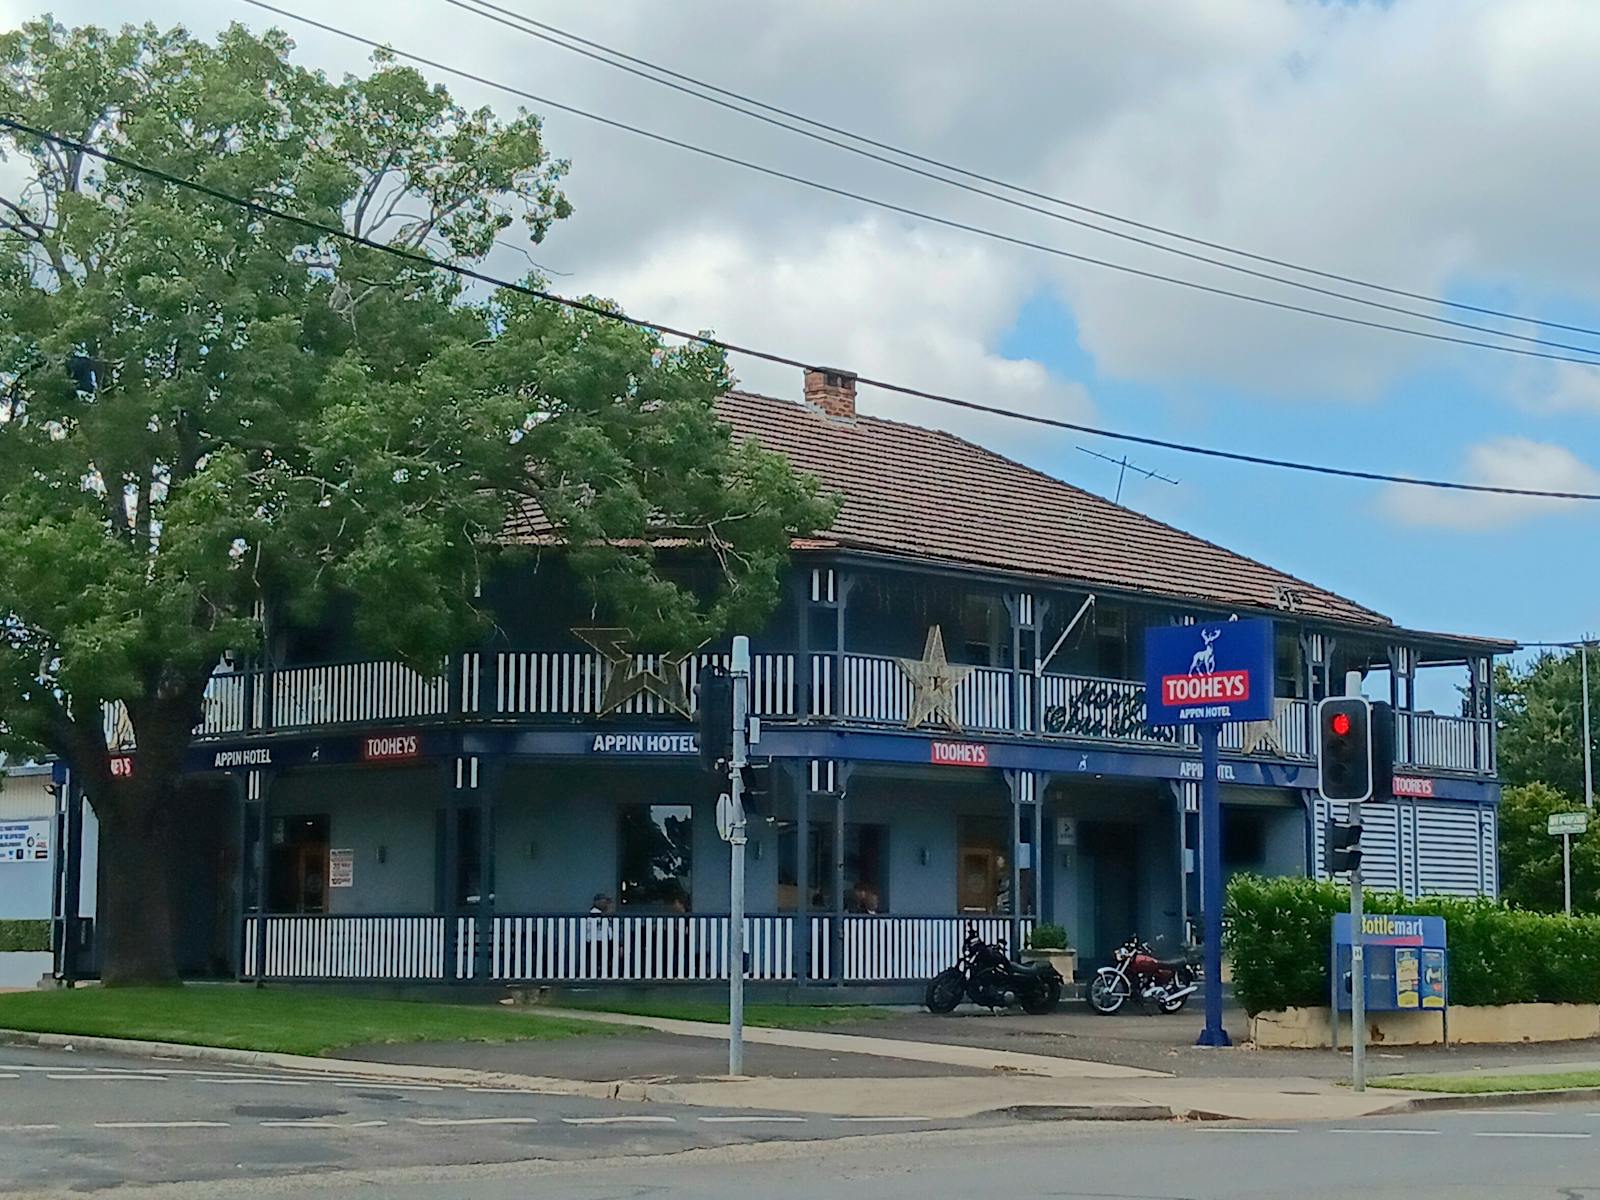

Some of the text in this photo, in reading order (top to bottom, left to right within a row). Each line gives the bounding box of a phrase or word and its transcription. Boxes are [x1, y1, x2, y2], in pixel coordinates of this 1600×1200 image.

[1166, 675, 1245, 700] TOOHEYS
[1205, 705, 1231, 718] HOTEL
[367, 735, 416, 756] TOOHEYS
[593, 735, 698, 752] APPIN HOTEL
[933, 742, 985, 762] TOOHEYS
[214, 749, 271, 767] APPIN HOTEL
